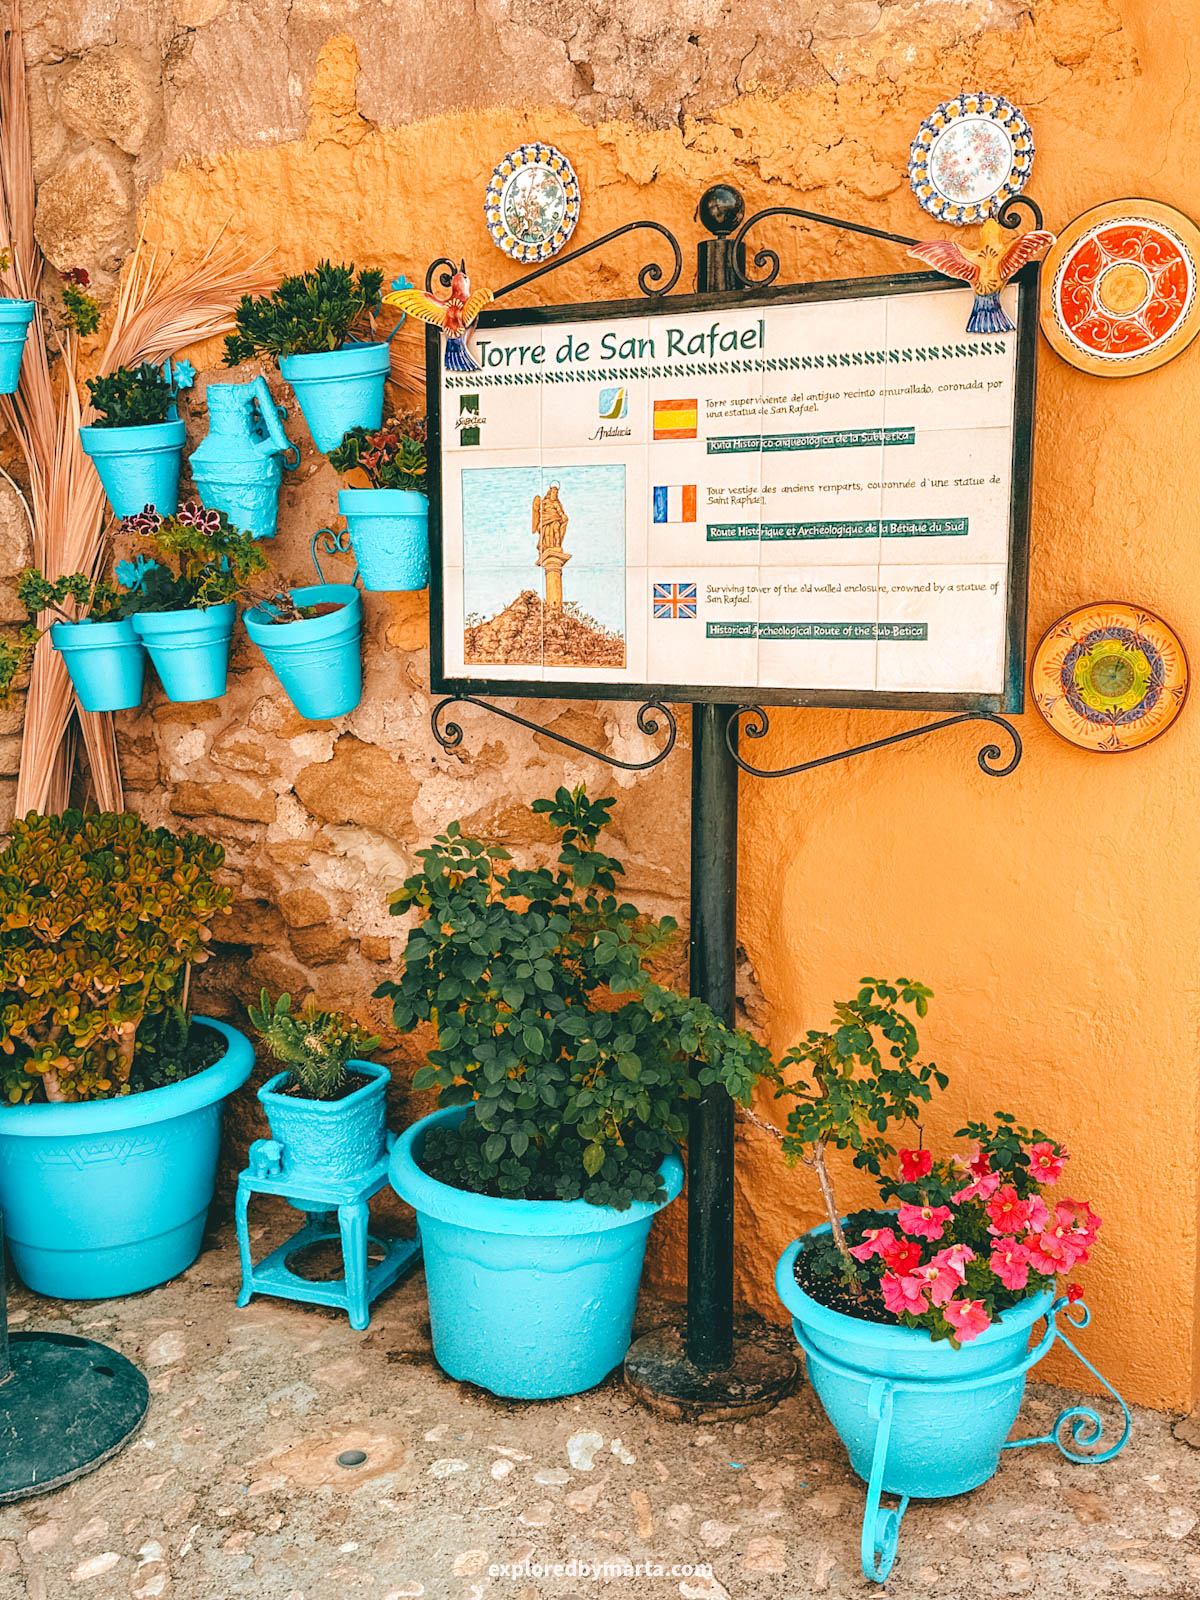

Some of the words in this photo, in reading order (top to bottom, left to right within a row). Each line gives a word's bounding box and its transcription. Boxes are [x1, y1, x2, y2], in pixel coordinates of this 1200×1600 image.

[476, 340, 546, 368] Torre
[555, 334, 590, 363] de
[600, 332, 656, 360] San
[666, 319, 766, 358] Rafael
[705, 398, 727, 408] Torre
[730, 394, 788, 407] superviviente
[791, 392, 804, 402] del
[806, 390, 841, 403] antiguo
[843, 387, 876, 399] recinto
[938, 379, 984, 393] coronada
[987, 379, 1004, 393] por
[706, 409, 723, 418] una
[724, 406, 756, 417] estatua
[758, 405, 769, 416] de
[770, 405, 787, 415] San
[789, 402, 819, 416] Rafael.
[835, 432, 849, 443] de
[850, 432, 859, 443] la
[706, 486, 725, 496] Tour
[728, 485, 758, 497] vestige
[762, 484, 777, 494] des
[781, 483, 815, 493] anciens
[819, 482, 863, 495] remparts,
[953, 476, 985, 487] statue
[989, 474, 1001, 484] de
[706, 496, 729, 505] Saint
[710, 527, 737, 537] Route
[738, 525, 784, 539] Historique
[786, 526, 797, 537] et
[865, 522, 877, 533] de
[879, 522, 888, 533] la
[929, 521, 942, 532] du
[944, 520, 965, 531] Sud
[706, 584, 745, 595] Surviving
[746, 585, 771, 594] tower
[773, 584, 783, 596] of
[783, 584, 798, 593] the
[800, 583, 812, 593] old
[814, 583, 842, 593] walled
[844, 583, 889, 595] enclosure,
[891, 582, 931, 593] crowned
[932, 582, 946, 595] by
[947, 584, 954, 592] a
[956, 583, 986, 592] statue
[989, 582, 1000, 595] of
[706, 595, 722, 604] San
[709, 625, 751, 635] Historical
[751, 626, 812, 638] Archeological
[813, 626, 840, 636] Route
[842, 625, 853, 636] of
[854, 626, 870, 635] the
[871, 626, 924, 636] Sub-Betica
